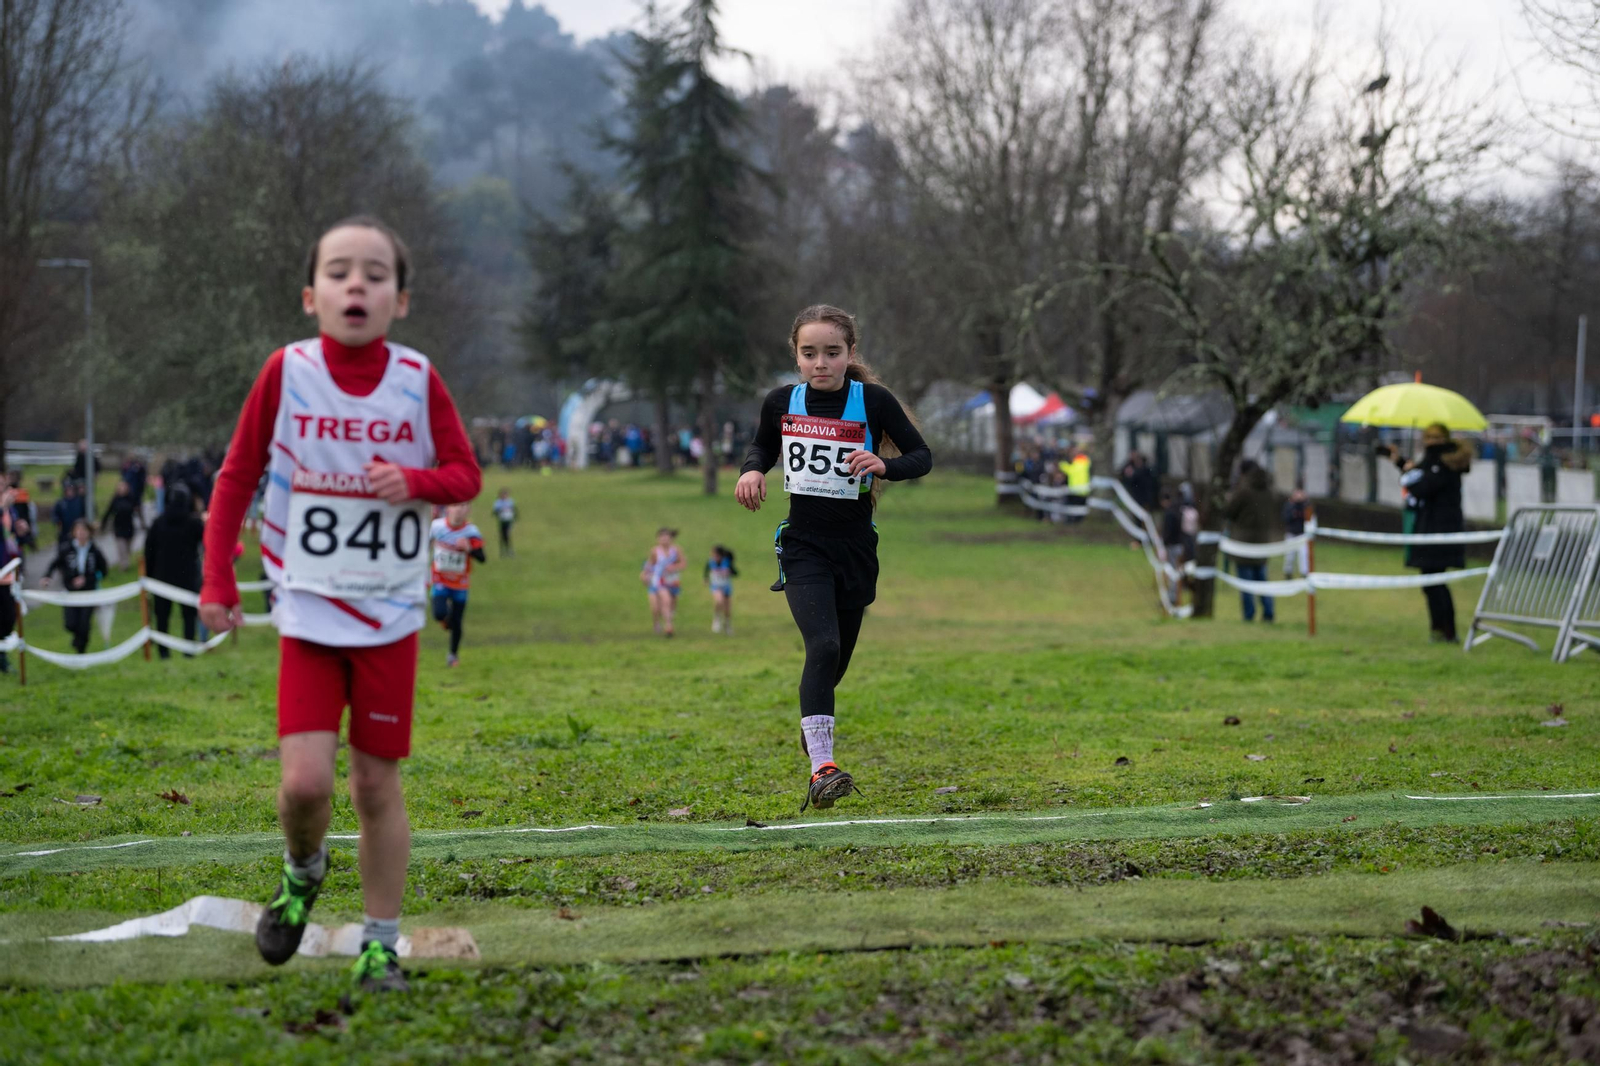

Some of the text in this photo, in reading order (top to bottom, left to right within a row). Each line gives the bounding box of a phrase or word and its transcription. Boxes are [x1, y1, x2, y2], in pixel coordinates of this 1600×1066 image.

[293, 414, 414, 444] TREGA
[839, 428, 864, 439] 2026
[788, 441, 857, 478] 855
[300, 506, 421, 561] 840
